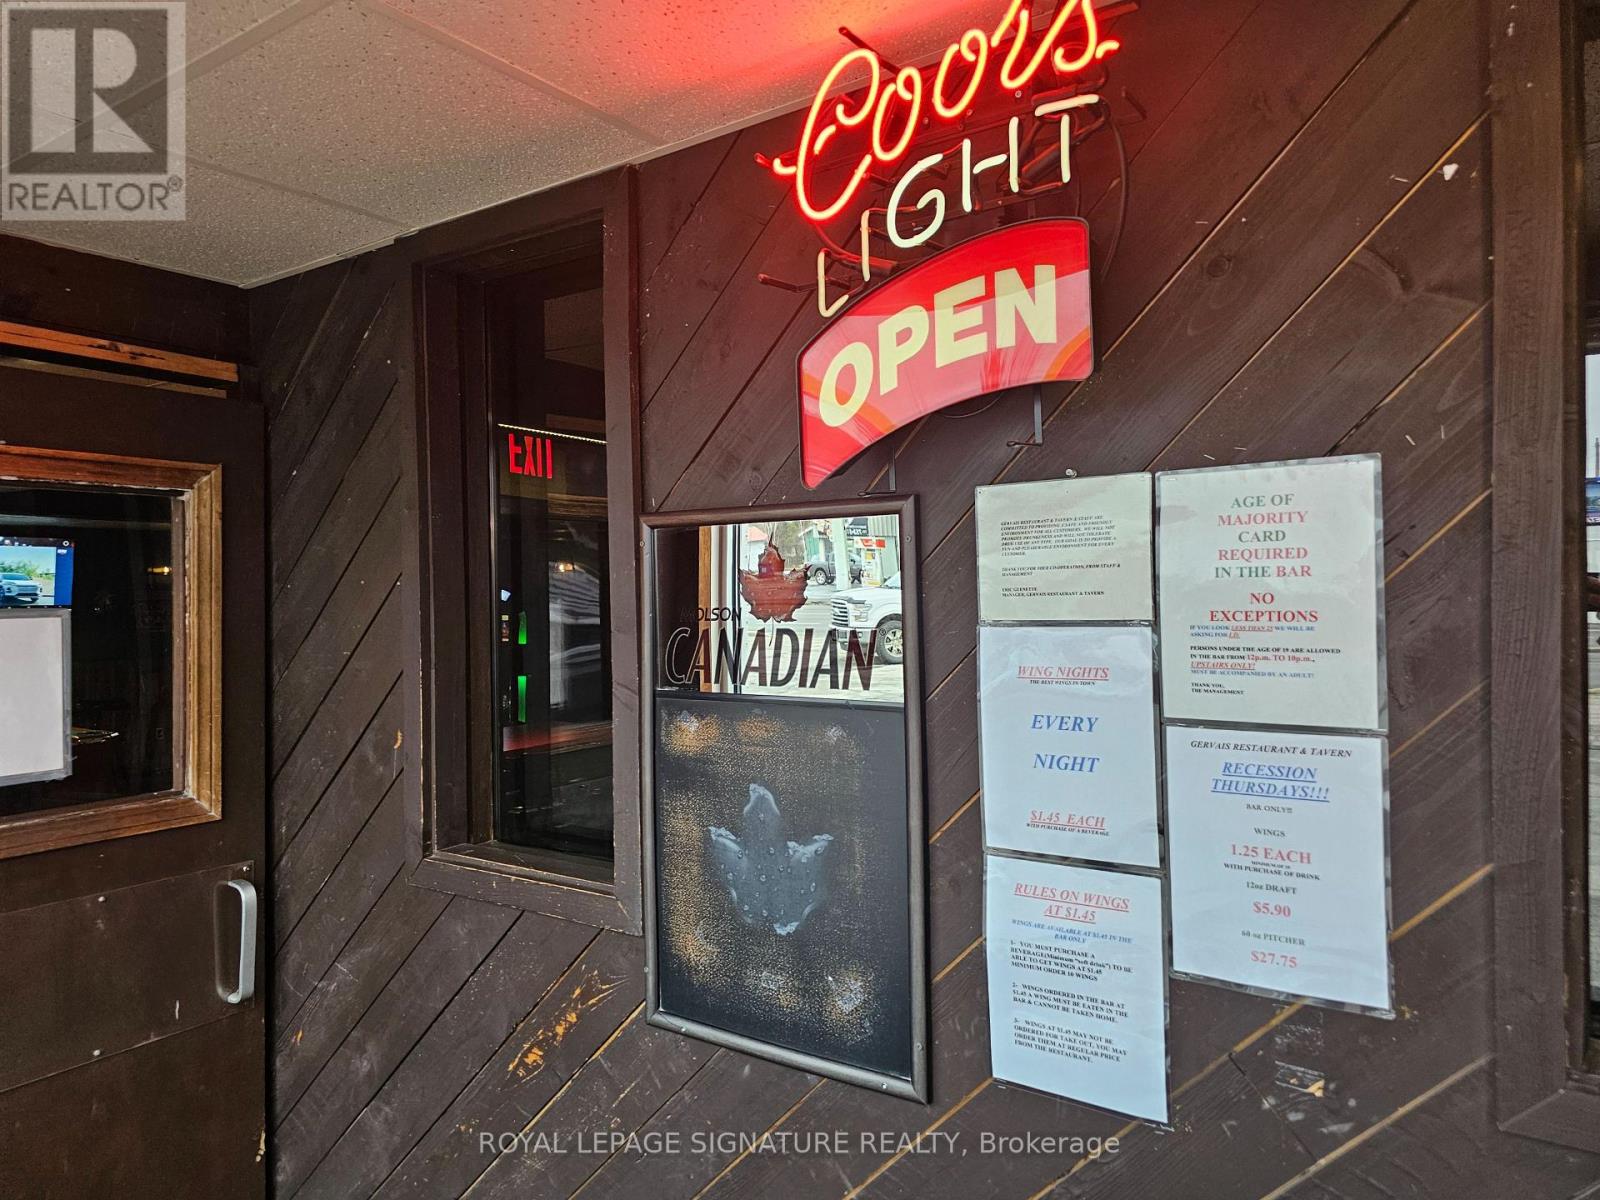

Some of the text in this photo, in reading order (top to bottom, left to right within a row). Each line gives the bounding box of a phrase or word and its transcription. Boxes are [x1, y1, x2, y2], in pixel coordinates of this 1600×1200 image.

[773, 0, 1120, 220] Coors
[817, 94, 1100, 318] LIGHT
[818, 264, 1058, 428] OPEN
[1231, 494, 1295, 508] AGE OF
[1218, 511, 1308, 526] MAJORITY
[1238, 530, 1286, 543] CARD
[1218, 547, 1308, 563] REQUIRED
[1215, 565, 1312, 578] IN THE BAR
[1250, 593, 1274, 604] NO
[1210, 610, 1318, 622] EXCEPTIONS
[665, 627, 877, 691] CANADIAN
[1018, 666, 1110, 678] WING NIGHTS
[1032, 714, 1099, 732] EVERY
[1191, 741, 1230, 750] GERVAIS
[1233, 743, 1297, 754] RESTAURANT
[1311, 748, 1352, 757] TAVERN
[1034, 754, 1099, 772] NIGHT
[1222, 762, 1317, 780] RECESSION
[1212, 778, 1330, 799] THURSDAYS!!!
[1030, 810, 1105, 828] $1.45 EACH
[1254, 827, 1285, 837] WINGS
[1232, 844, 1312, 864] 1.25 EACH
[1224, 863, 1320, 880] WITH PURCHASE OF DRINK
[1015, 883, 1129, 909] RULES ON WINGS
[1246, 881, 1297, 894] 12oz DRAFT
[1044, 905, 1096, 920] AT $1.45
[1253, 901, 1291, 917] $5.90
[1263, 933, 1305, 945] PITCHER
[1020, 941, 1032, 949] YOU
[1035, 944, 1052, 952] MUST
[1055, 947, 1088, 957] PURCHASE
[1011, 954, 1027, 962] ABLE
[1054, 961, 1075, 970] WINGS
[1251, 951, 1297, 968] $27.75
[1011, 961, 1041, 971] MINIMUM
[1043, 966, 1066, 975] ORDER
[1076, 971, 1098, 980] WINGS
[1022, 984, 1043, 993] WINGS
[1045, 988, 1075, 999] ORDERED
[1086, 996, 1098, 1004] THE
[1101, 999, 1114, 1007] BAR
[1013, 996, 1025, 1004] BAR
[1034, 1001, 1060, 1011] CANNOT
[1062, 1006, 1071, 1014] BE
[1072, 1009, 1094, 1018] TAKEN
[1034, 994, 1051, 1003] WING
[1053, 998, 1070, 1006] MUST
[1083, 1003, 1104, 1013] EATEN
[1115, 1009, 1128, 1017] THE
[1025, 1020, 1045, 1030] WINGS
[1073, 1030, 1087, 1039] MAY
[1089, 1034, 1102, 1042] NOT
[1014, 1025, 1044, 1037] ORDERED
[1045, 1032, 1058, 1040] FOR
[1060, 1035, 1077, 1044] TAKE
[1096, 1043, 1110, 1051] YOU
[1112, 1046, 1127, 1055] MAY
[1014, 1040, 1032, 1049] FROM
[1035, 1044, 1046, 1052] THE
[1014, 1032, 1035, 1042] ORDER
[1038, 1037, 1055, 1047] THEM
[1068, 1044, 1098, 1057] REGULAR
[1101, 1052, 1120, 1061] PRICE
